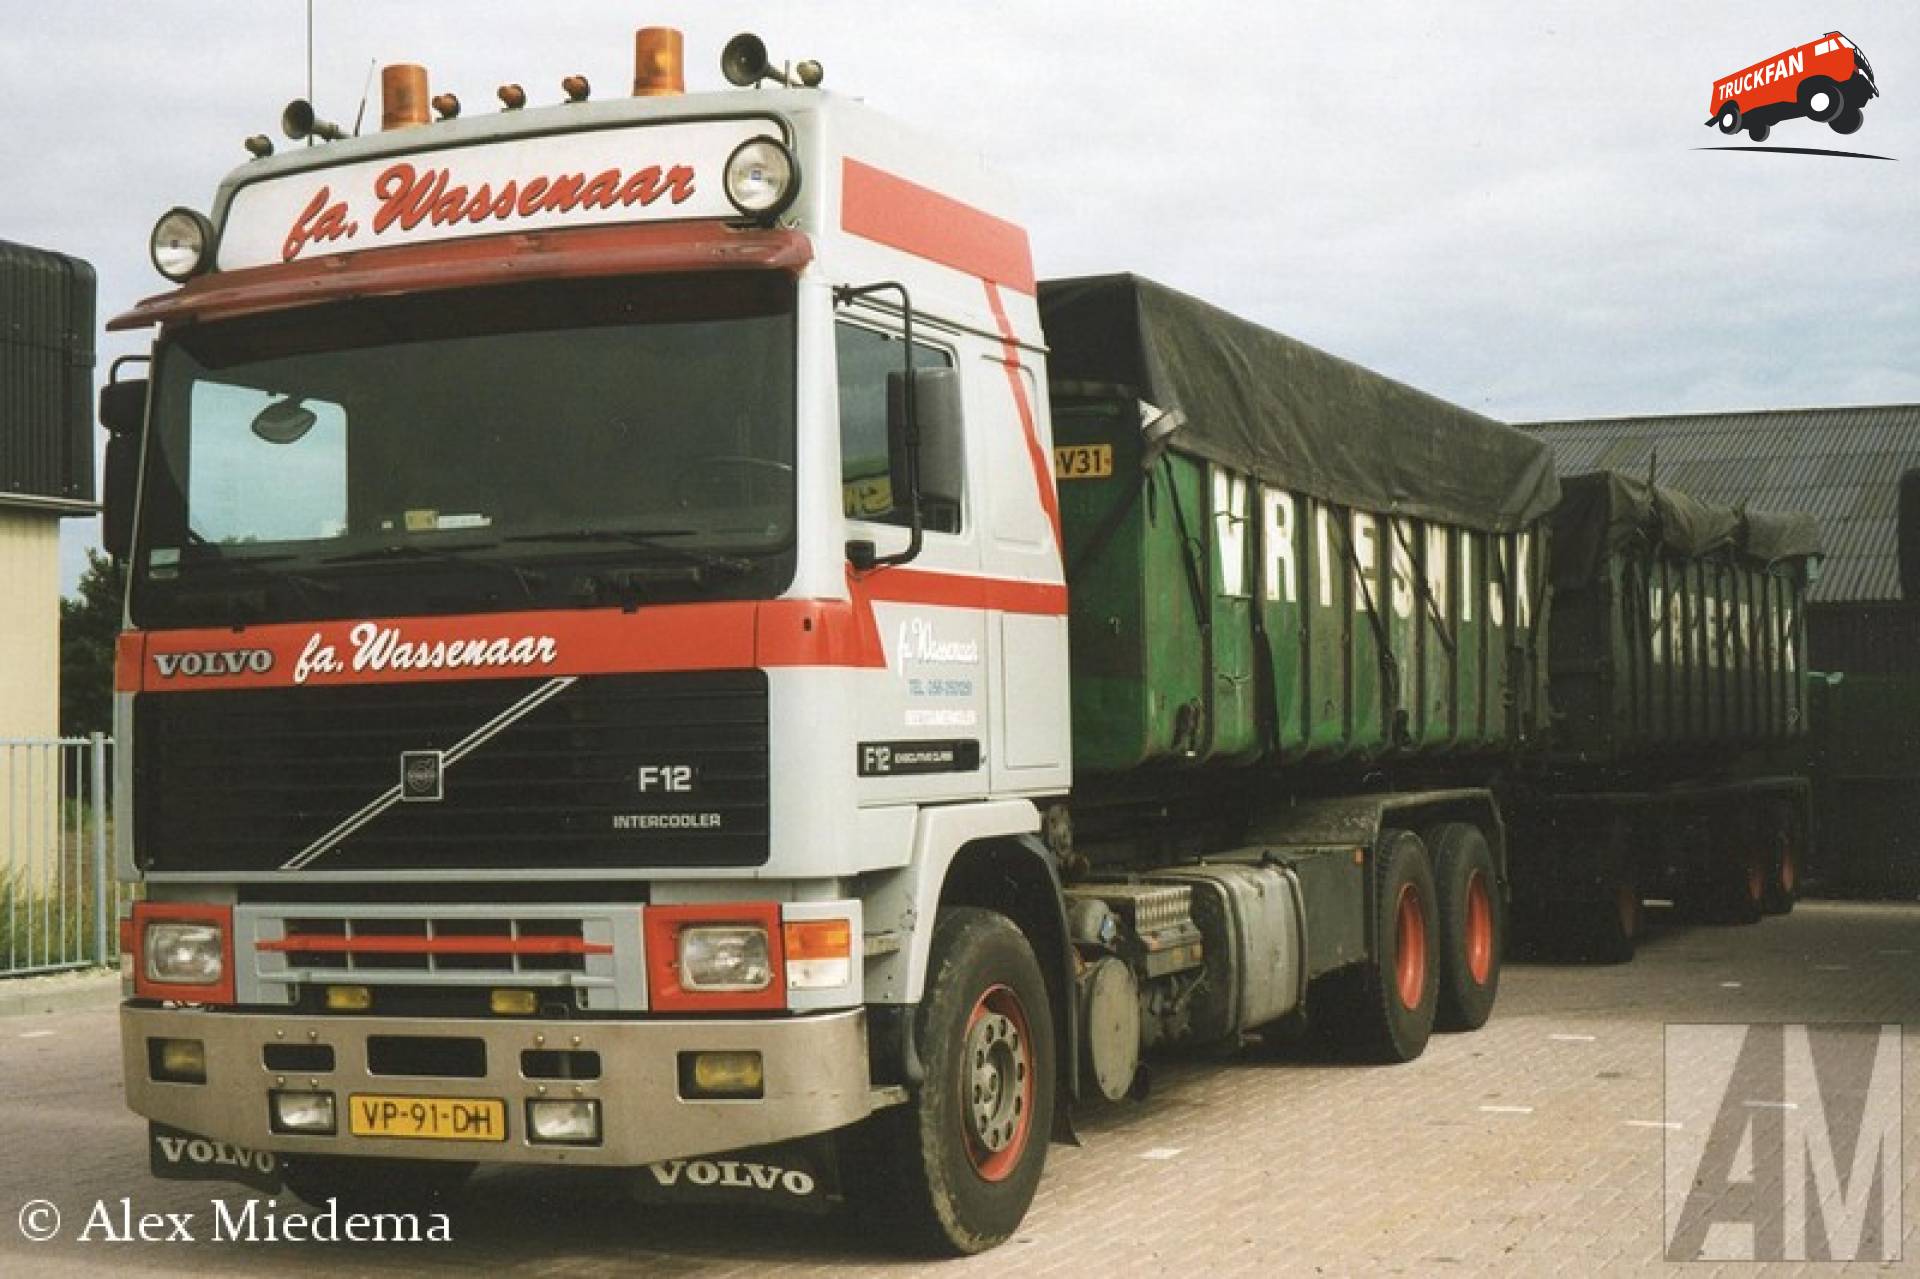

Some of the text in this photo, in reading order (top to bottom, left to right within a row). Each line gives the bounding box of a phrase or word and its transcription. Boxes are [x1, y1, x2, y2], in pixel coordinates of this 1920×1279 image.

[369, 162, 695, 236] Wassenaar
[153, 648, 274, 676] VOLVO
[349, 622, 558, 672] Wassenaar
[638, 765, 692, 793] F12
[613, 813, 721, 829] INTERCOOLER
[363, 1100, 492, 1135] VP-91-DH
[155, 1136, 275, 1173] VOLVO
[649, 1160, 815, 1196] VOLVO
